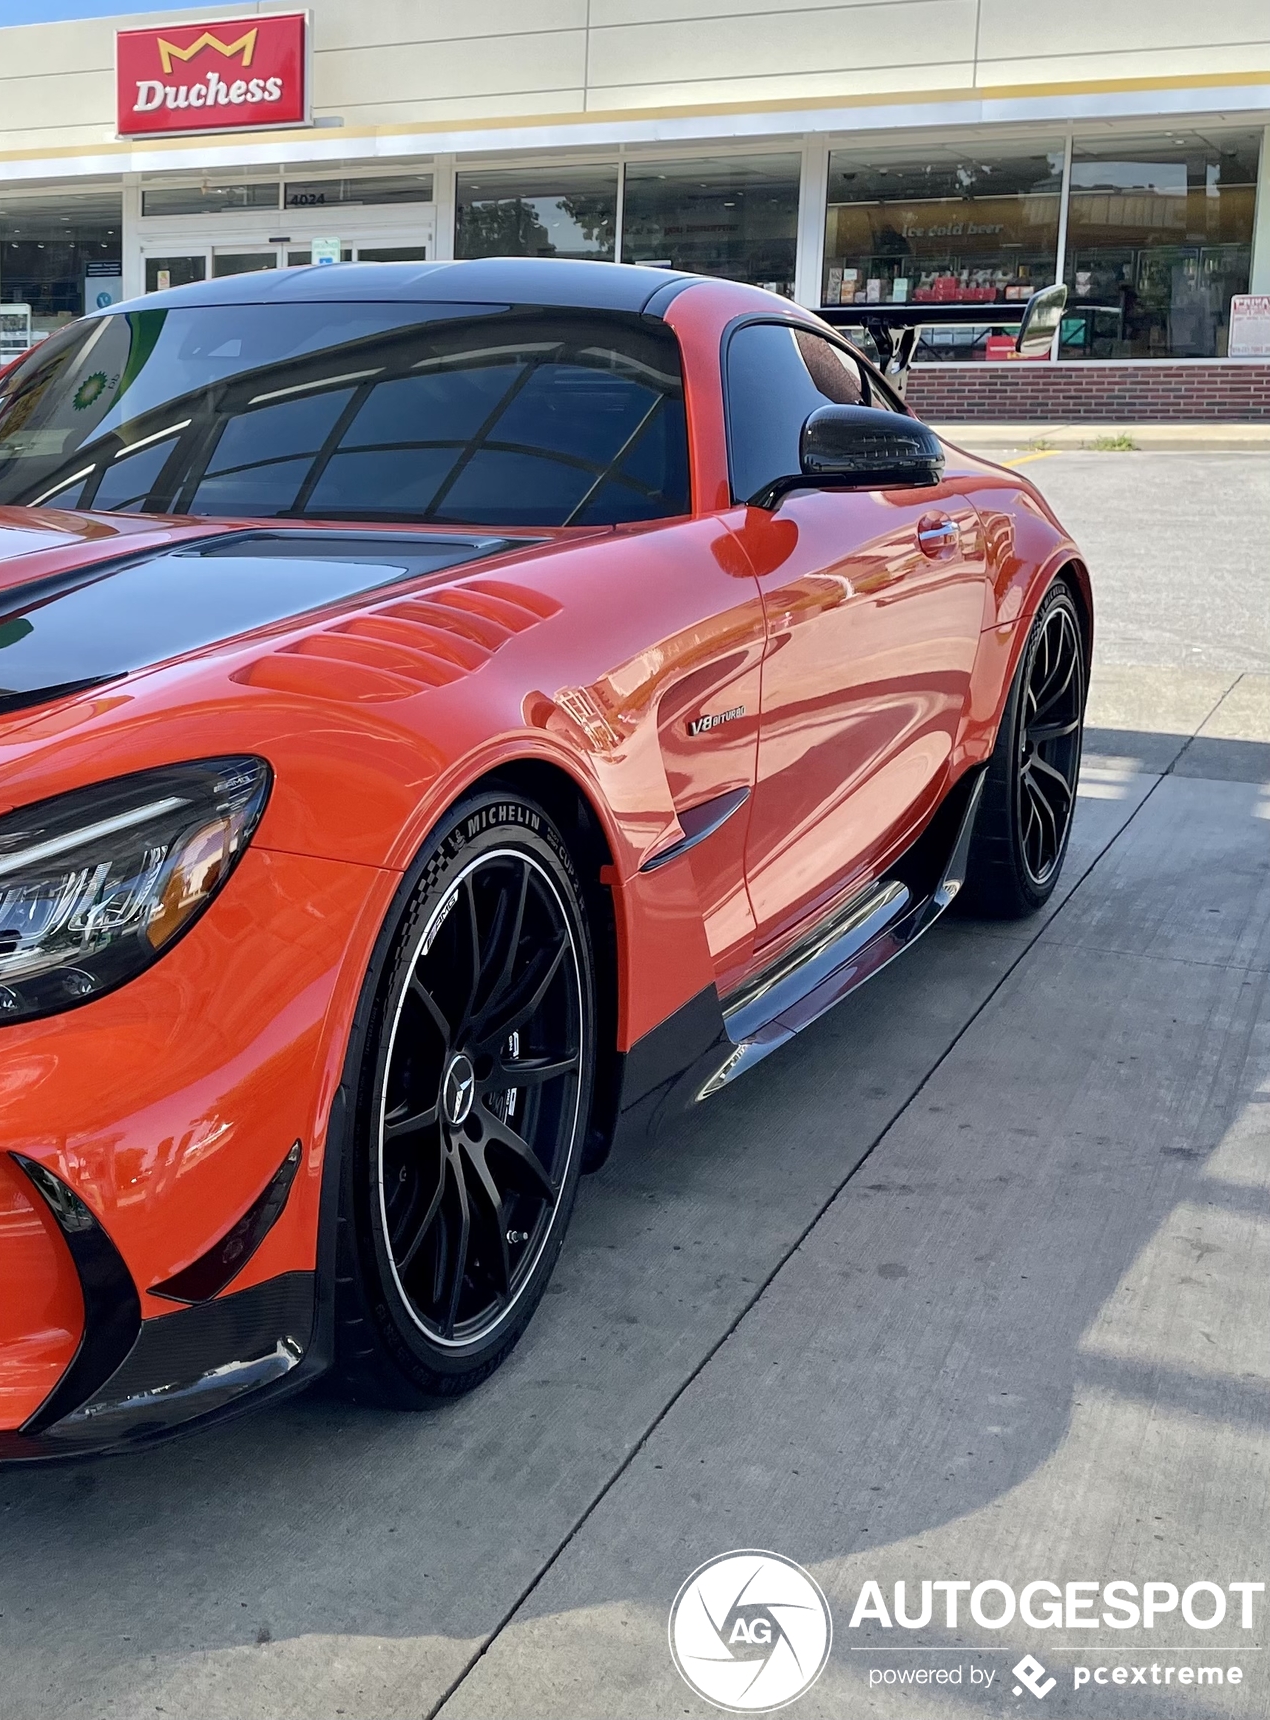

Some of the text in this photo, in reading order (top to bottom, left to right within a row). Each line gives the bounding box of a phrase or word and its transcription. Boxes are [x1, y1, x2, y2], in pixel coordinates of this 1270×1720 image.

[133, 71, 283, 112] Duchess
[291, 193, 325, 206] 4024
[928, 222, 966, 237] cold
[967, 221, 1004, 235] beer
[690, 715, 712, 736] V8
[467, 805, 540, 838] MICHELIN
[559, 845, 579, 893] CUP 2
